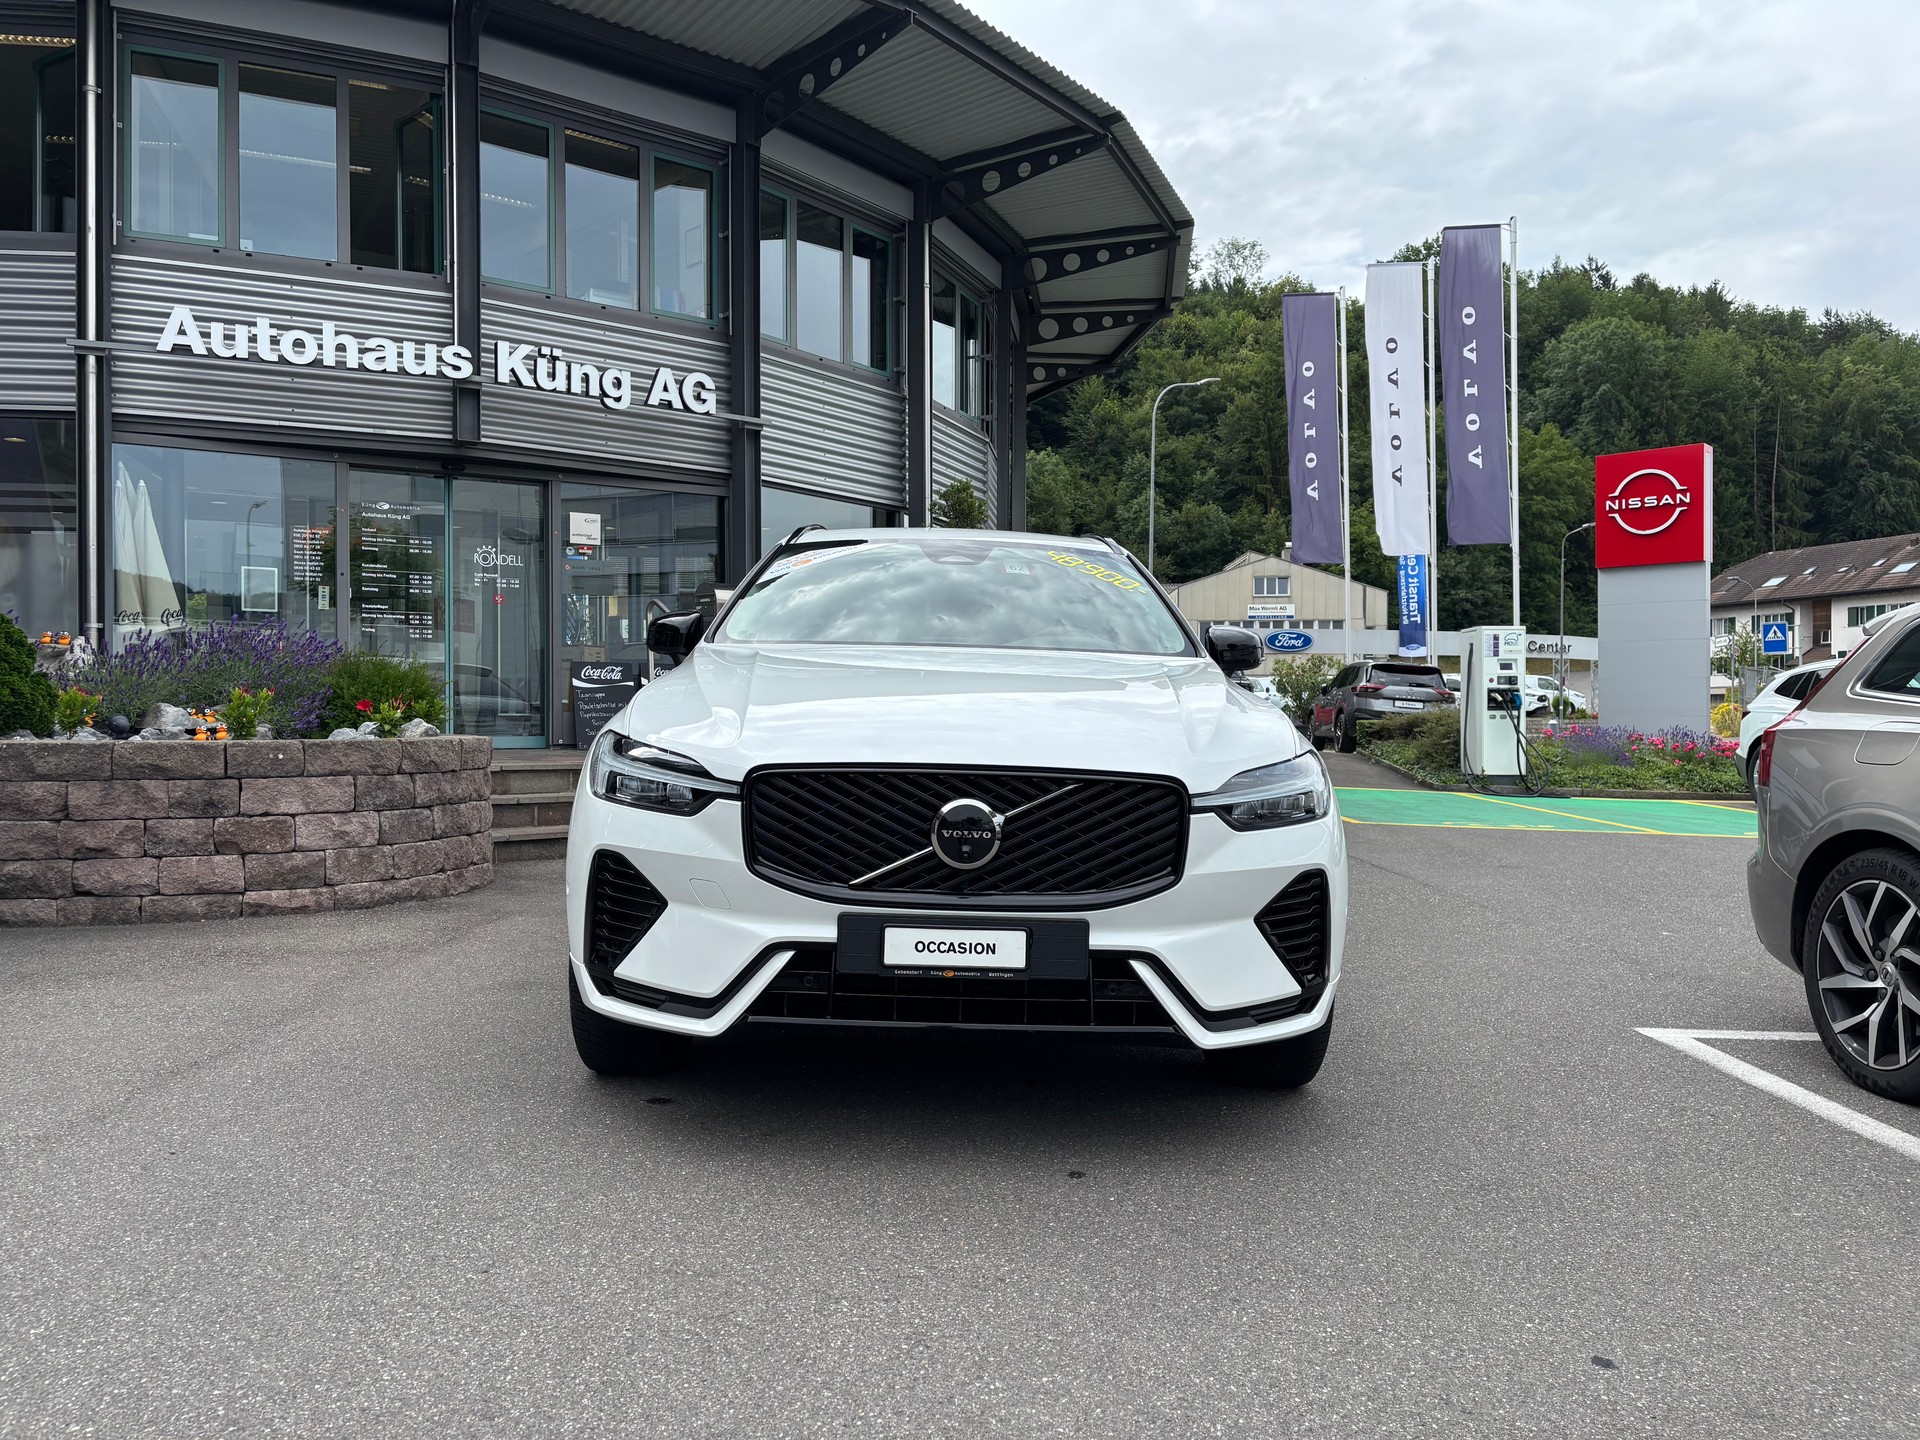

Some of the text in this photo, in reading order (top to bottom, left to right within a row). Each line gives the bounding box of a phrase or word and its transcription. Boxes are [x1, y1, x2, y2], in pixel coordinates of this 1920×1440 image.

[156, 306, 717, 414] Autohaus Küng AG
[1605, 492, 1690, 511] NISSAN
[361, 511, 387, 519] Autohaus
[473, 552, 524, 567] RONDELL
[1275, 633, 1304, 647] Ford
[1527, 640, 1572, 653] Center
[941, 829, 992, 839] VOLVO
[1860, 858, 1890, 871] 235/45
[1891, 864, 1898, 875] R
[1898, 868, 1908, 880] 18
[914, 941, 996, 955] OCCASION
